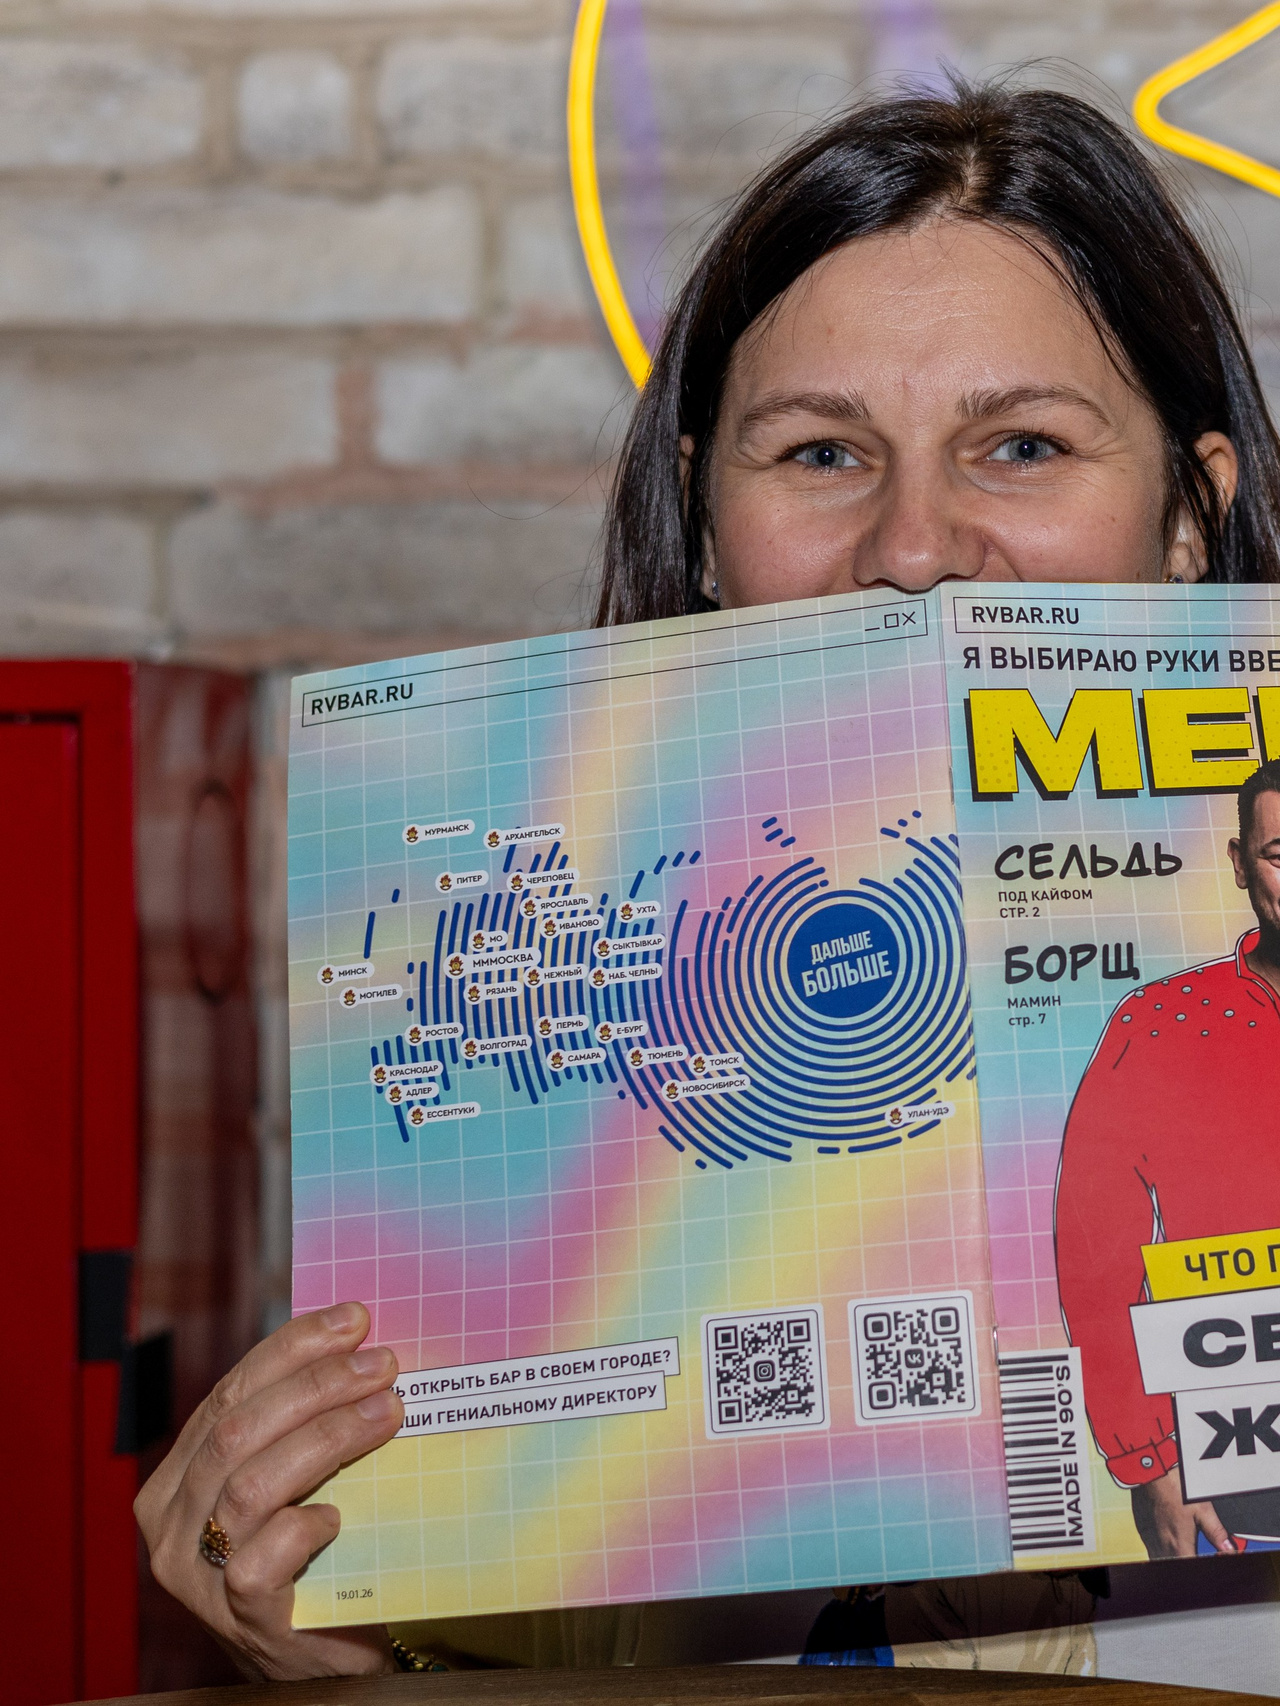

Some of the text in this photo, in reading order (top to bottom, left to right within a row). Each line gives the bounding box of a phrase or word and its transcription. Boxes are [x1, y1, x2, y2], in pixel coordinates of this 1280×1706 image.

[971, 606, 1080, 625] RVBAR.RU
[963, 647, 981, 669] Я
[990, 647, 1137, 672] ВЫБИРАЮ
[1146, 650, 1219, 672] РУКИ
[311, 682, 413, 715] RVBAR.RU
[424, 823, 470, 837] МУРМАНСК
[504, 827, 561, 841] АРХАНГЕЛЬСК
[994, 842, 1183, 881] СЕЛЬДЬ
[456, 874, 483, 885] ПИТЕР
[526, 872, 575, 885] ЧЕРЕПОВЕЦ
[998, 888, 1093, 903] ПОД КАЙФОМ
[540, 898, 589, 910] ЯРОСЛАВЛЬ
[636, 905, 657, 915] УХТА
[1000, 907, 1040, 918] СТР. 2
[559, 919, 600, 931] ИВАНОВО
[489, 935, 503, 943] МО
[612, 938, 663, 951] СЫКТЫВКАР
[810, 930, 873, 965] ДАЛЬШЕ
[472, 953, 534, 968] МММОСКВА
[1005, 942, 1140, 984] БОРЩ
[338, 966, 368, 977] МИНСК
[544, 966, 583, 979] НЕЖНЫЙ
[608, 967, 658, 980] НАБ. ЧЕЛНЫ
[801, 950, 893, 997] БОЛЬШЕ
[359, 988, 398, 1000] МОГИЛЕВ
[486, 985, 517, 996] РЯЗАНЬ
[1008, 995, 1062, 1009] МАМИН
[556, 1019, 584, 1030] ПЕРМЬ
[1039, 1013, 1047, 1024] 7
[425, 1026, 459, 1037] РОСТОВ
[616, 1024, 645, 1035] Е-БУРГ
[480, 1038, 528, 1051] ВОЛГОГРАД
[567, 1052, 602, 1063] САМАРА
[647, 1049, 684, 1061] ТЮМЕНЬ
[709, 1056, 740, 1067] ТОМСК
[389, 1064, 439, 1078] КРАСНОДАР
[406, 1087, 433, 1097] АДЛЕР
[682, 1079, 746, 1094] НОВОСИБИРСК
[427, 1106, 475, 1119] ЕССЕНТУКИ
[907, 1106, 950, 1119] УЛАН-УДЭ
[1184, 1247, 1256, 1282] ЧТО
[410, 1375, 485, 1396] ОТКРЫТЬ
[490, 1369, 521, 1386] БАР
[525, 1368, 536, 1381] В
[540, 1360, 595, 1379] СВОЕМ
[600, 1349, 671, 1371] ГОРОДЕ?
[437, 1397, 557, 1423] ГЕНИАЛЬНОМУ
[562, 1385, 657, 1411] ДИРЕКТОРУ
[1064, 1462, 1084, 1537] MADE
[336, 1588, 374, 1600] 19.01.26
